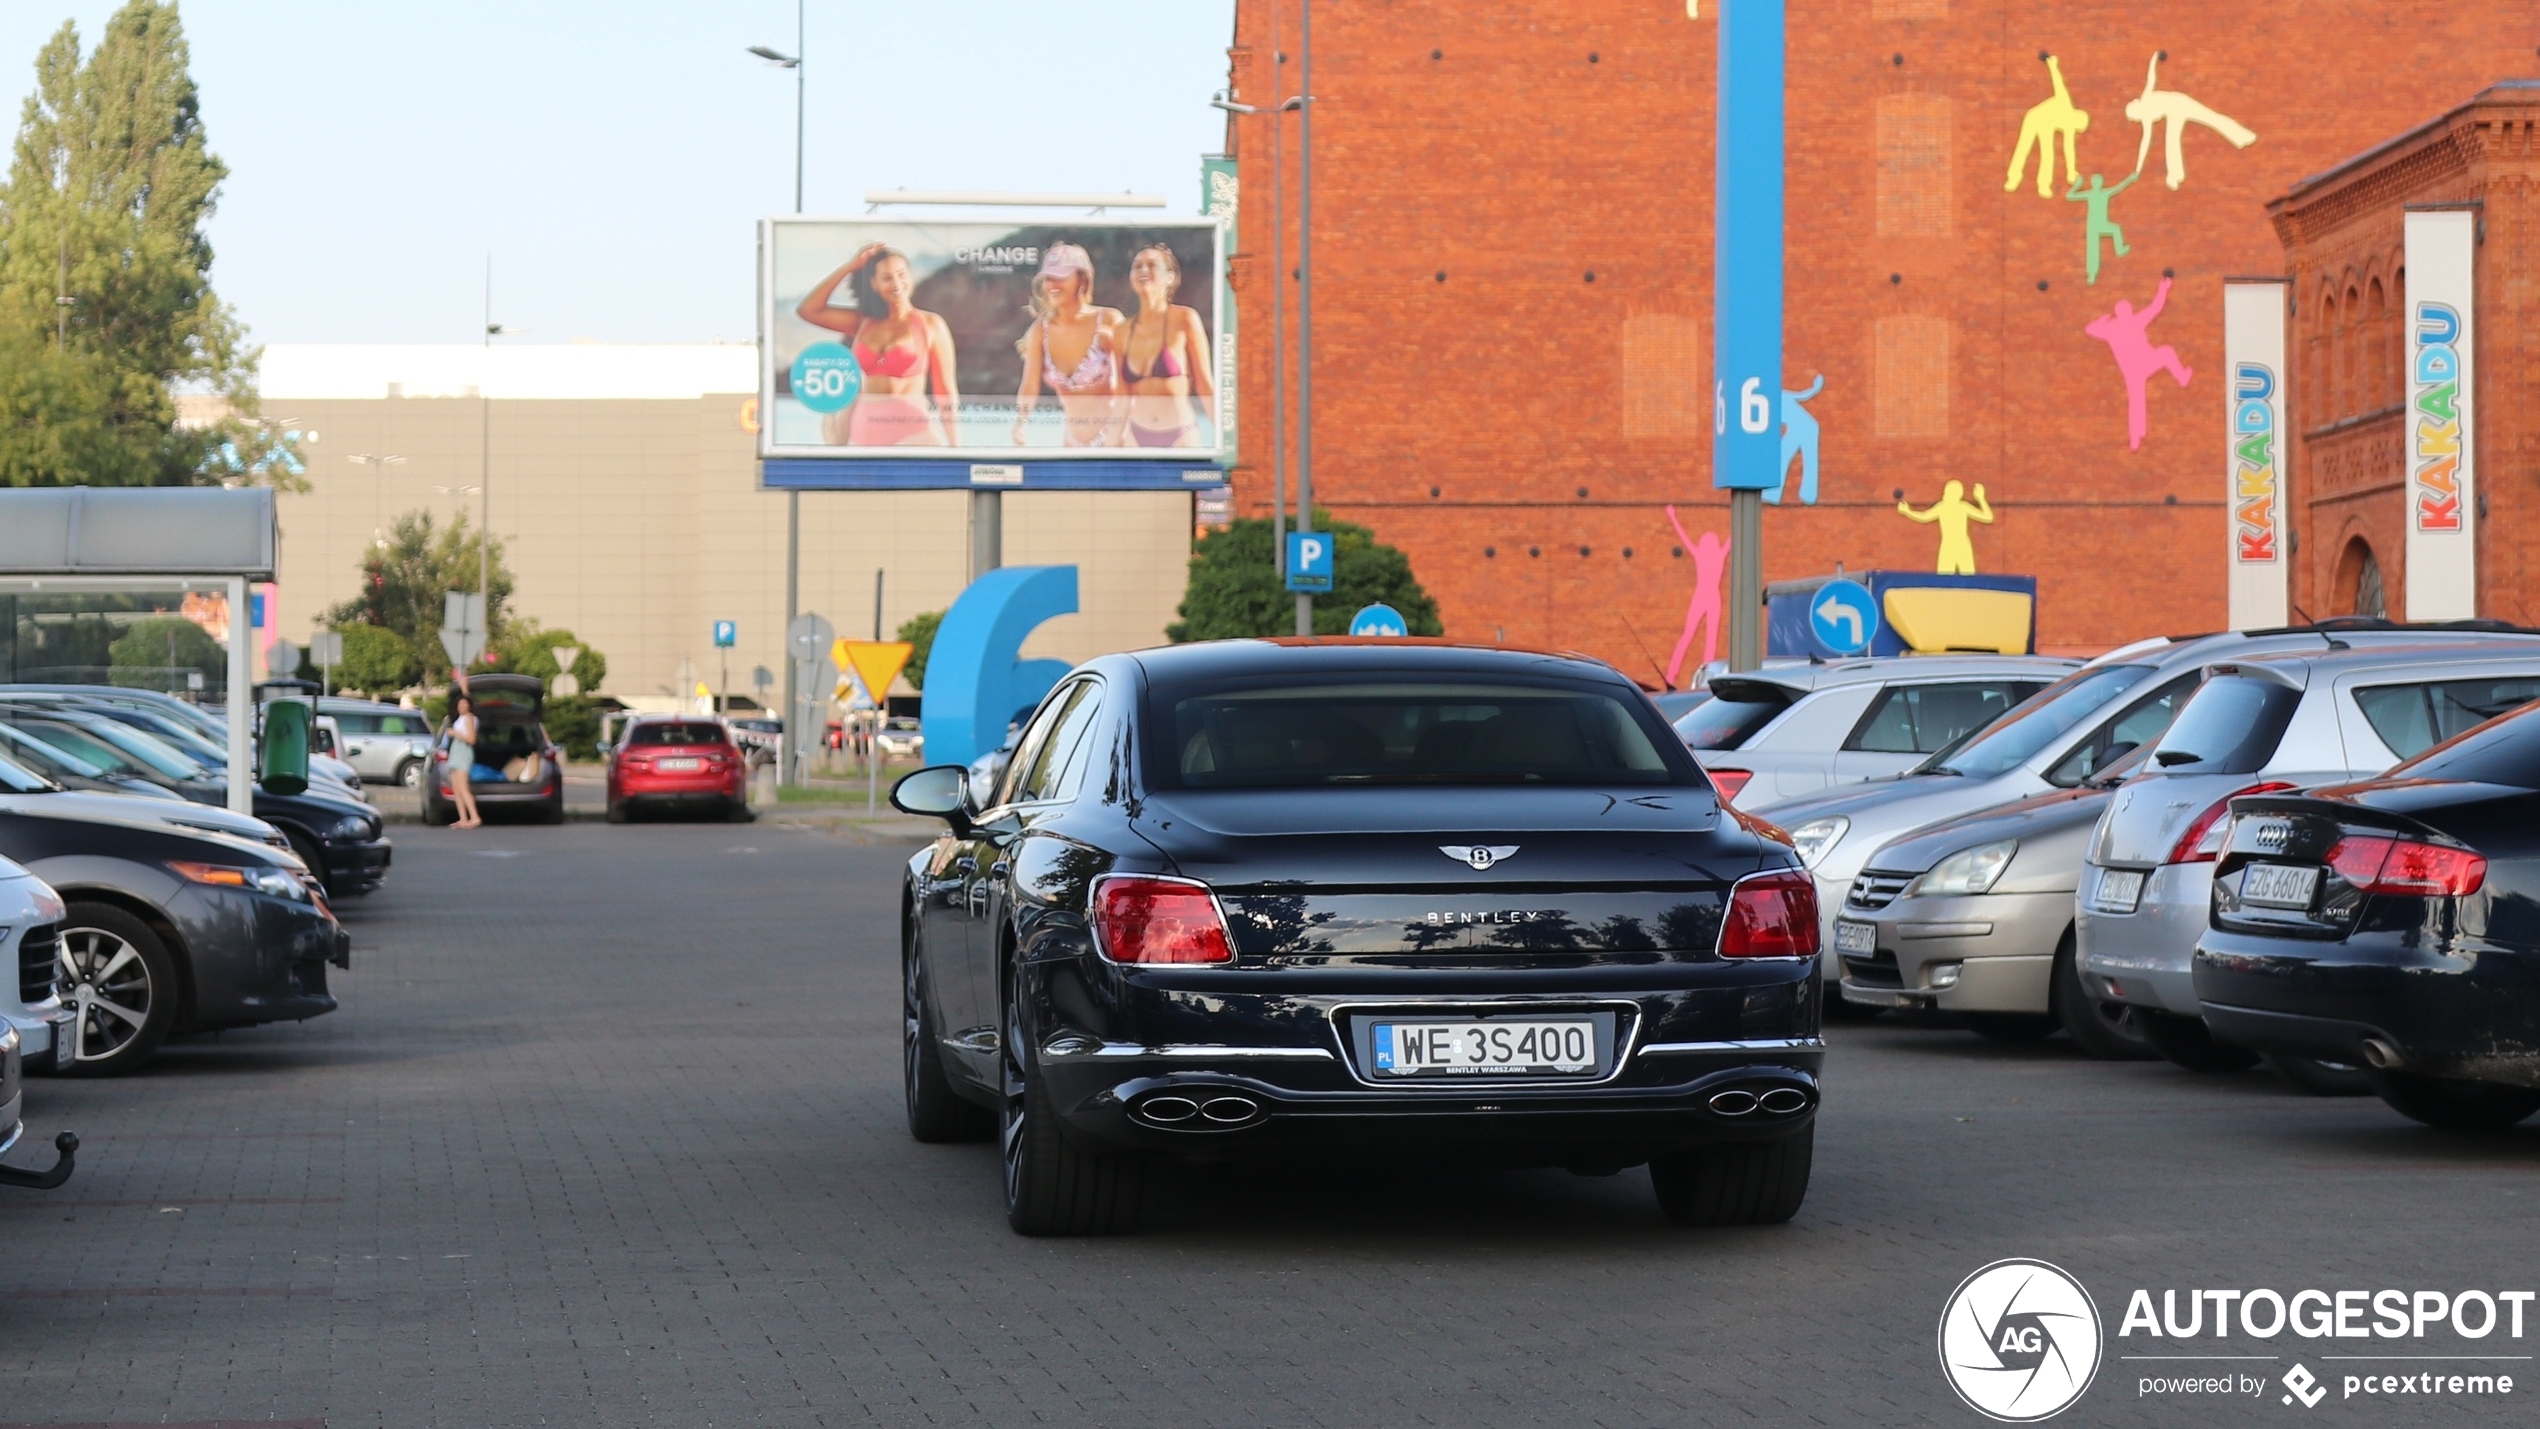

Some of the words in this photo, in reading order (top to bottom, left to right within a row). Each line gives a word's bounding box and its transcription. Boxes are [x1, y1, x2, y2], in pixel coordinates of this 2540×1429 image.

[955, 246, 1039, 265] CHANGE
[794, 368, 857, 397] -50%
[1717, 378, 1726, 436] 6
[1741, 376, 1769, 434] 6
[2415, 301, 2462, 532] KAKADU
[2235, 362, 2277, 564] KAKADU
[1301, 538, 1322, 571] P
[719, 621, 732, 639] P
[1473, 848, 1489, 862] B
[2245, 866, 2273, 897] EZG
[2272, 869, 2314, 903] 66014
[1427, 911, 1538, 924] BENTLEY
[1378, 1052, 1392, 1062] PL
[1402, 1028, 1451, 1065] WE
[1466, 1027, 1585, 1063] 3S400
